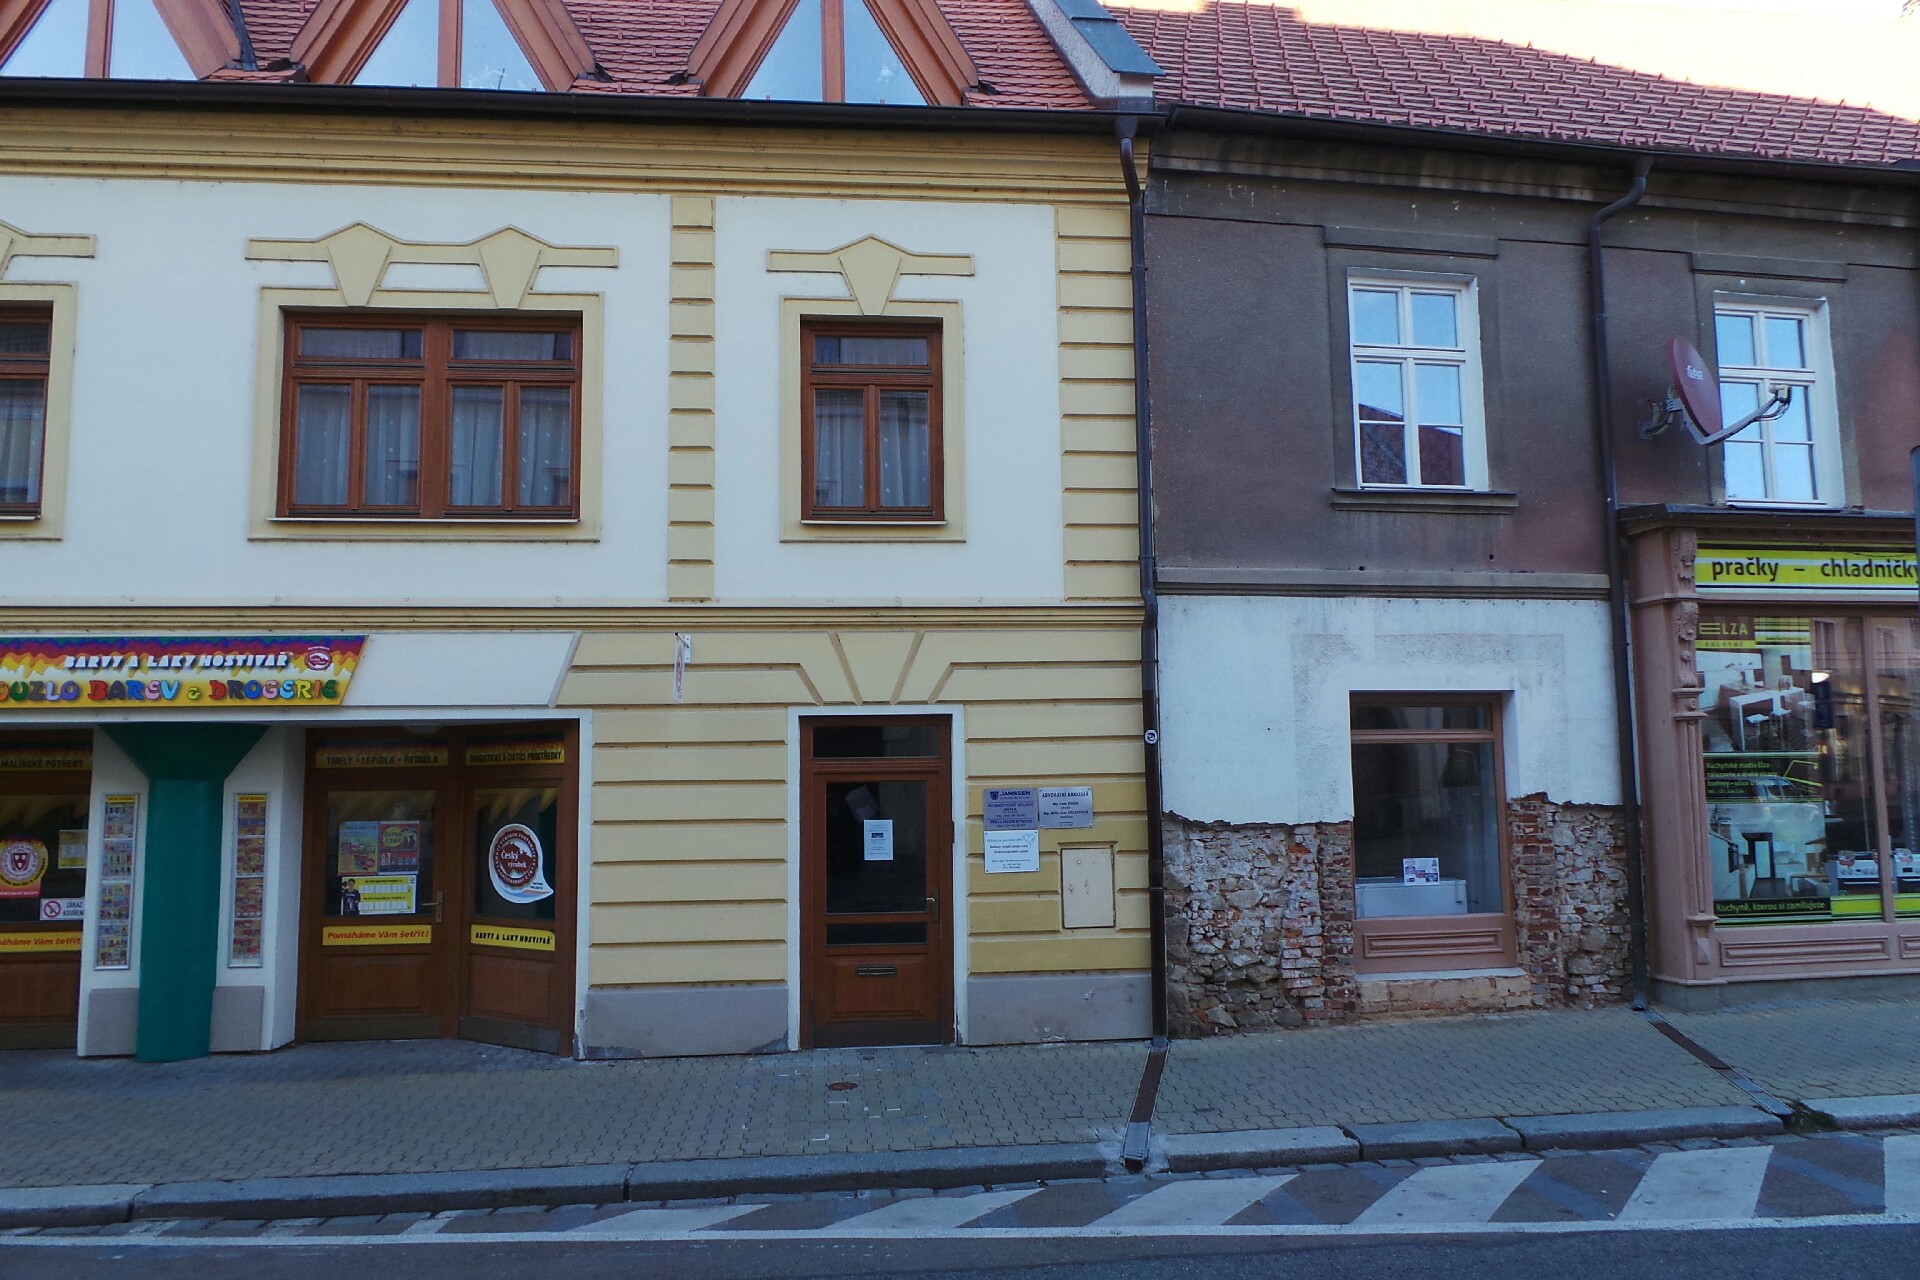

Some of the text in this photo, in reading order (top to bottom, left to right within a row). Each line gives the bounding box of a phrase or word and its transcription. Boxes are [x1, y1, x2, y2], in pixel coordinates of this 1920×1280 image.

[1712, 557, 1779, 582] pračky
[1699, 622, 1748, 635] ELZA
[64, 651, 288, 668] BARVY A LAKY HOSTIVAŘ
[87, 680, 180, 701] BAREV
[208, 679, 337, 700] DROGERIE
[327, 755, 352, 765] TMELY
[501, 849, 519, 862] Český
[507, 861, 527, 870] výrobek
[379, 931, 397, 939] Vám
[502, 934, 518, 942] LAKY
[33, 937, 53, 945] Vám
